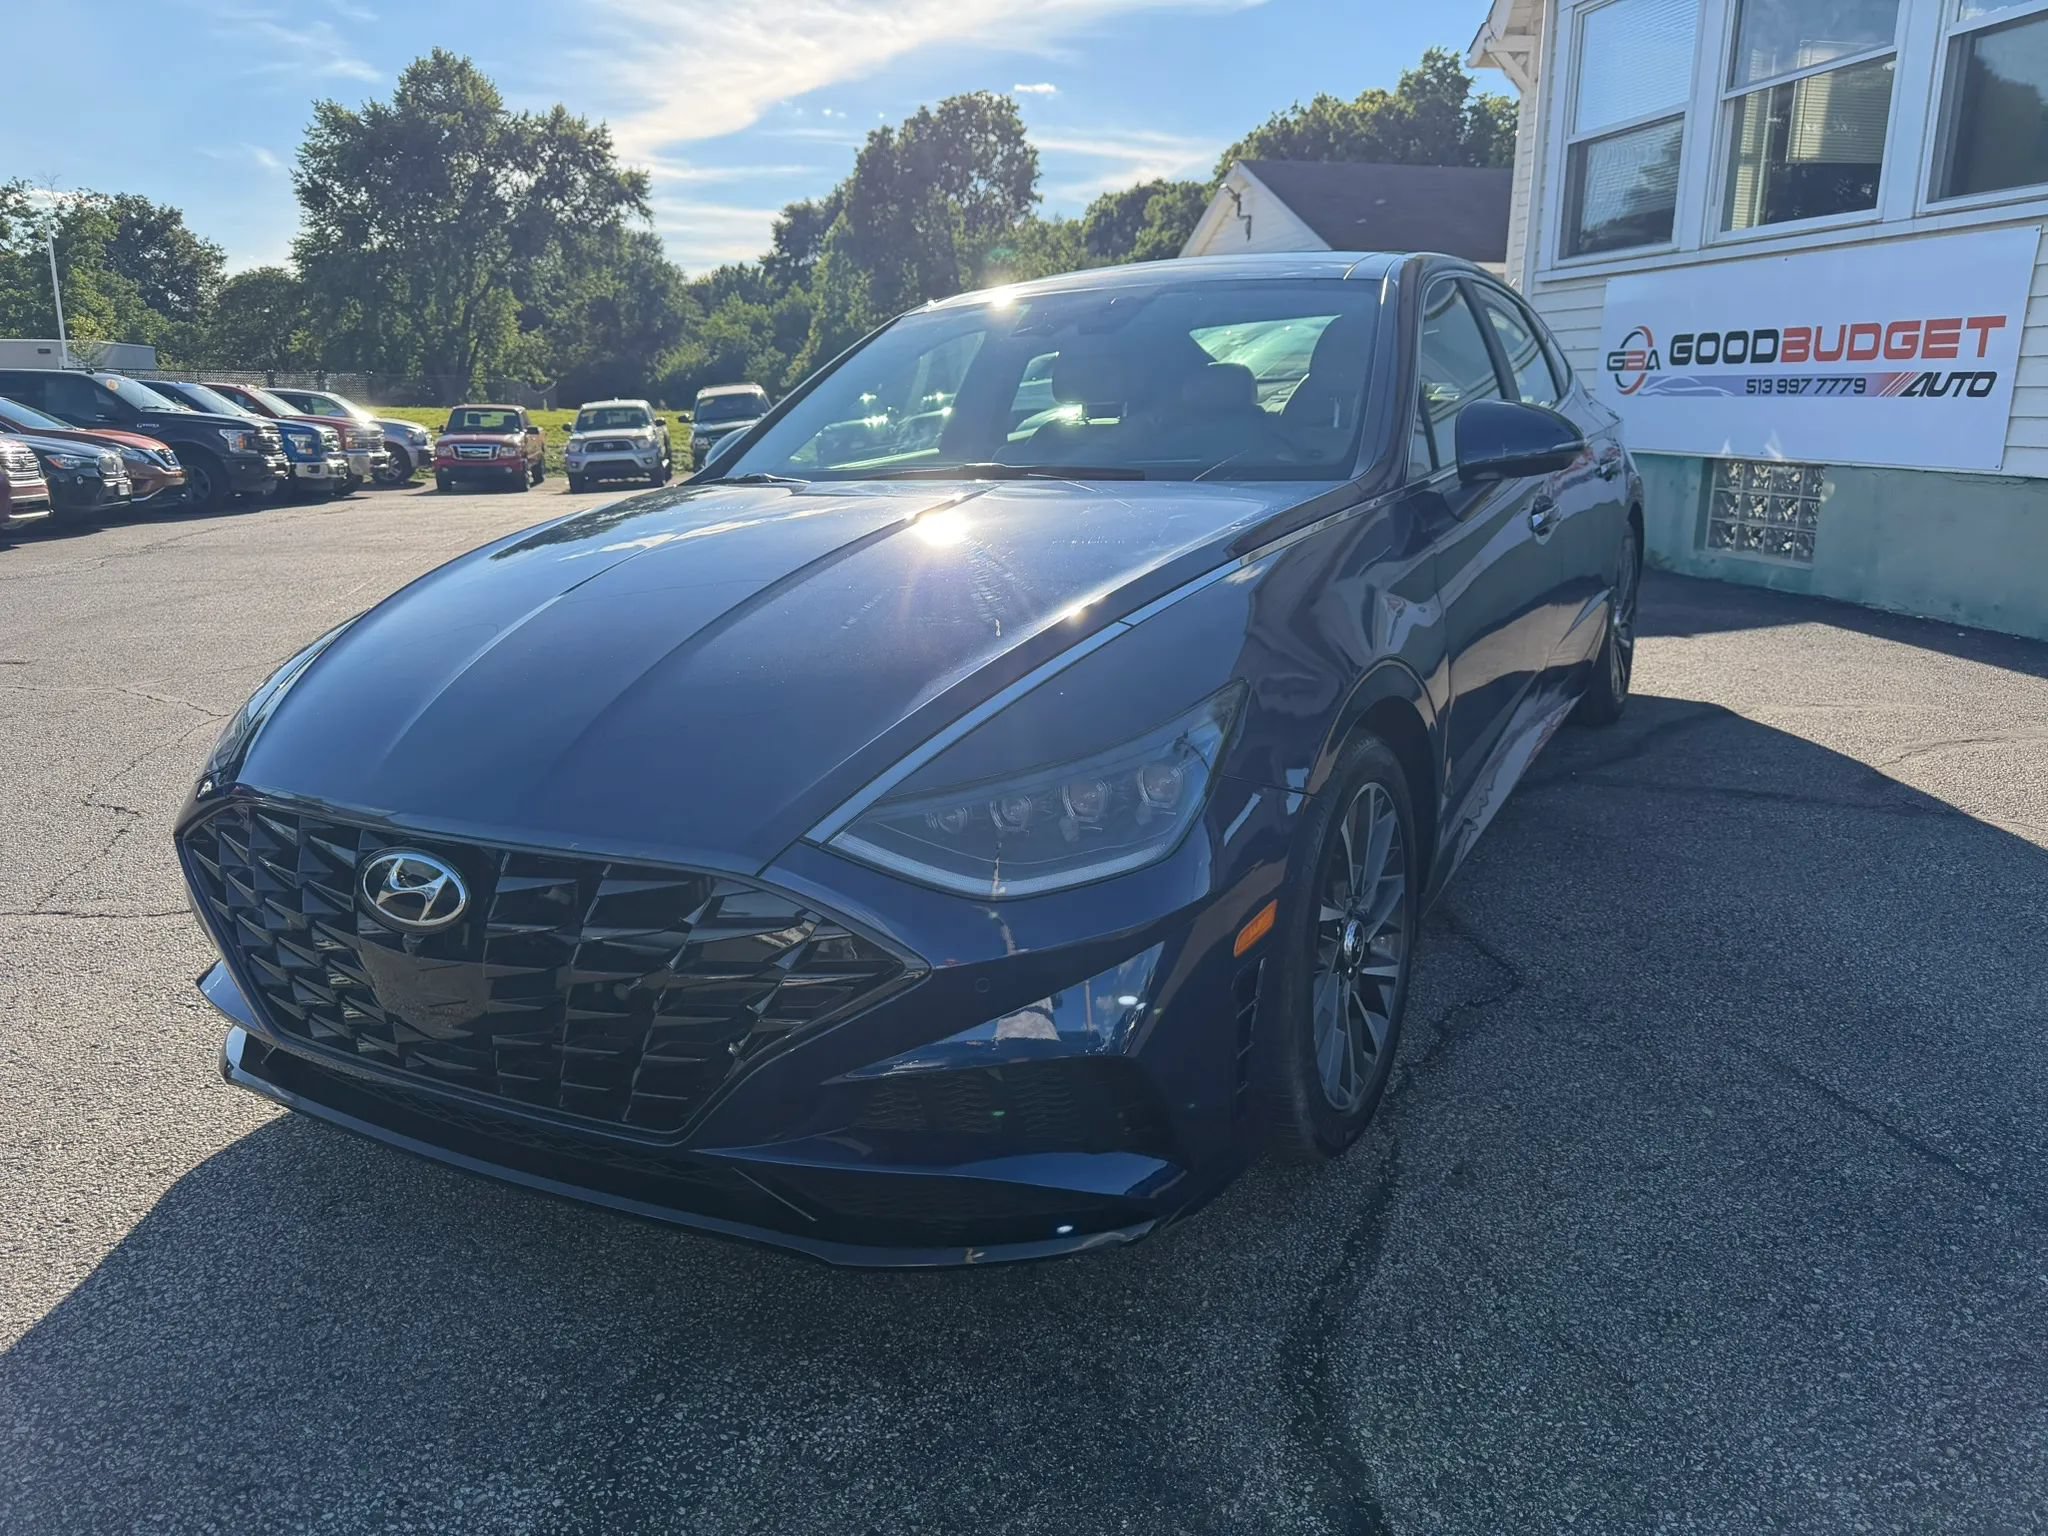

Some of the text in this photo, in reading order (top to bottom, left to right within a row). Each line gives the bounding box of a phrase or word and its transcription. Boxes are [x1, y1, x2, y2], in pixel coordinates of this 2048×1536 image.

[1607, 350, 1661, 371] GBA
[1746, 377, 1867, 394] 513 997 7779
[1900, 371, 1998, 398] AUTO
